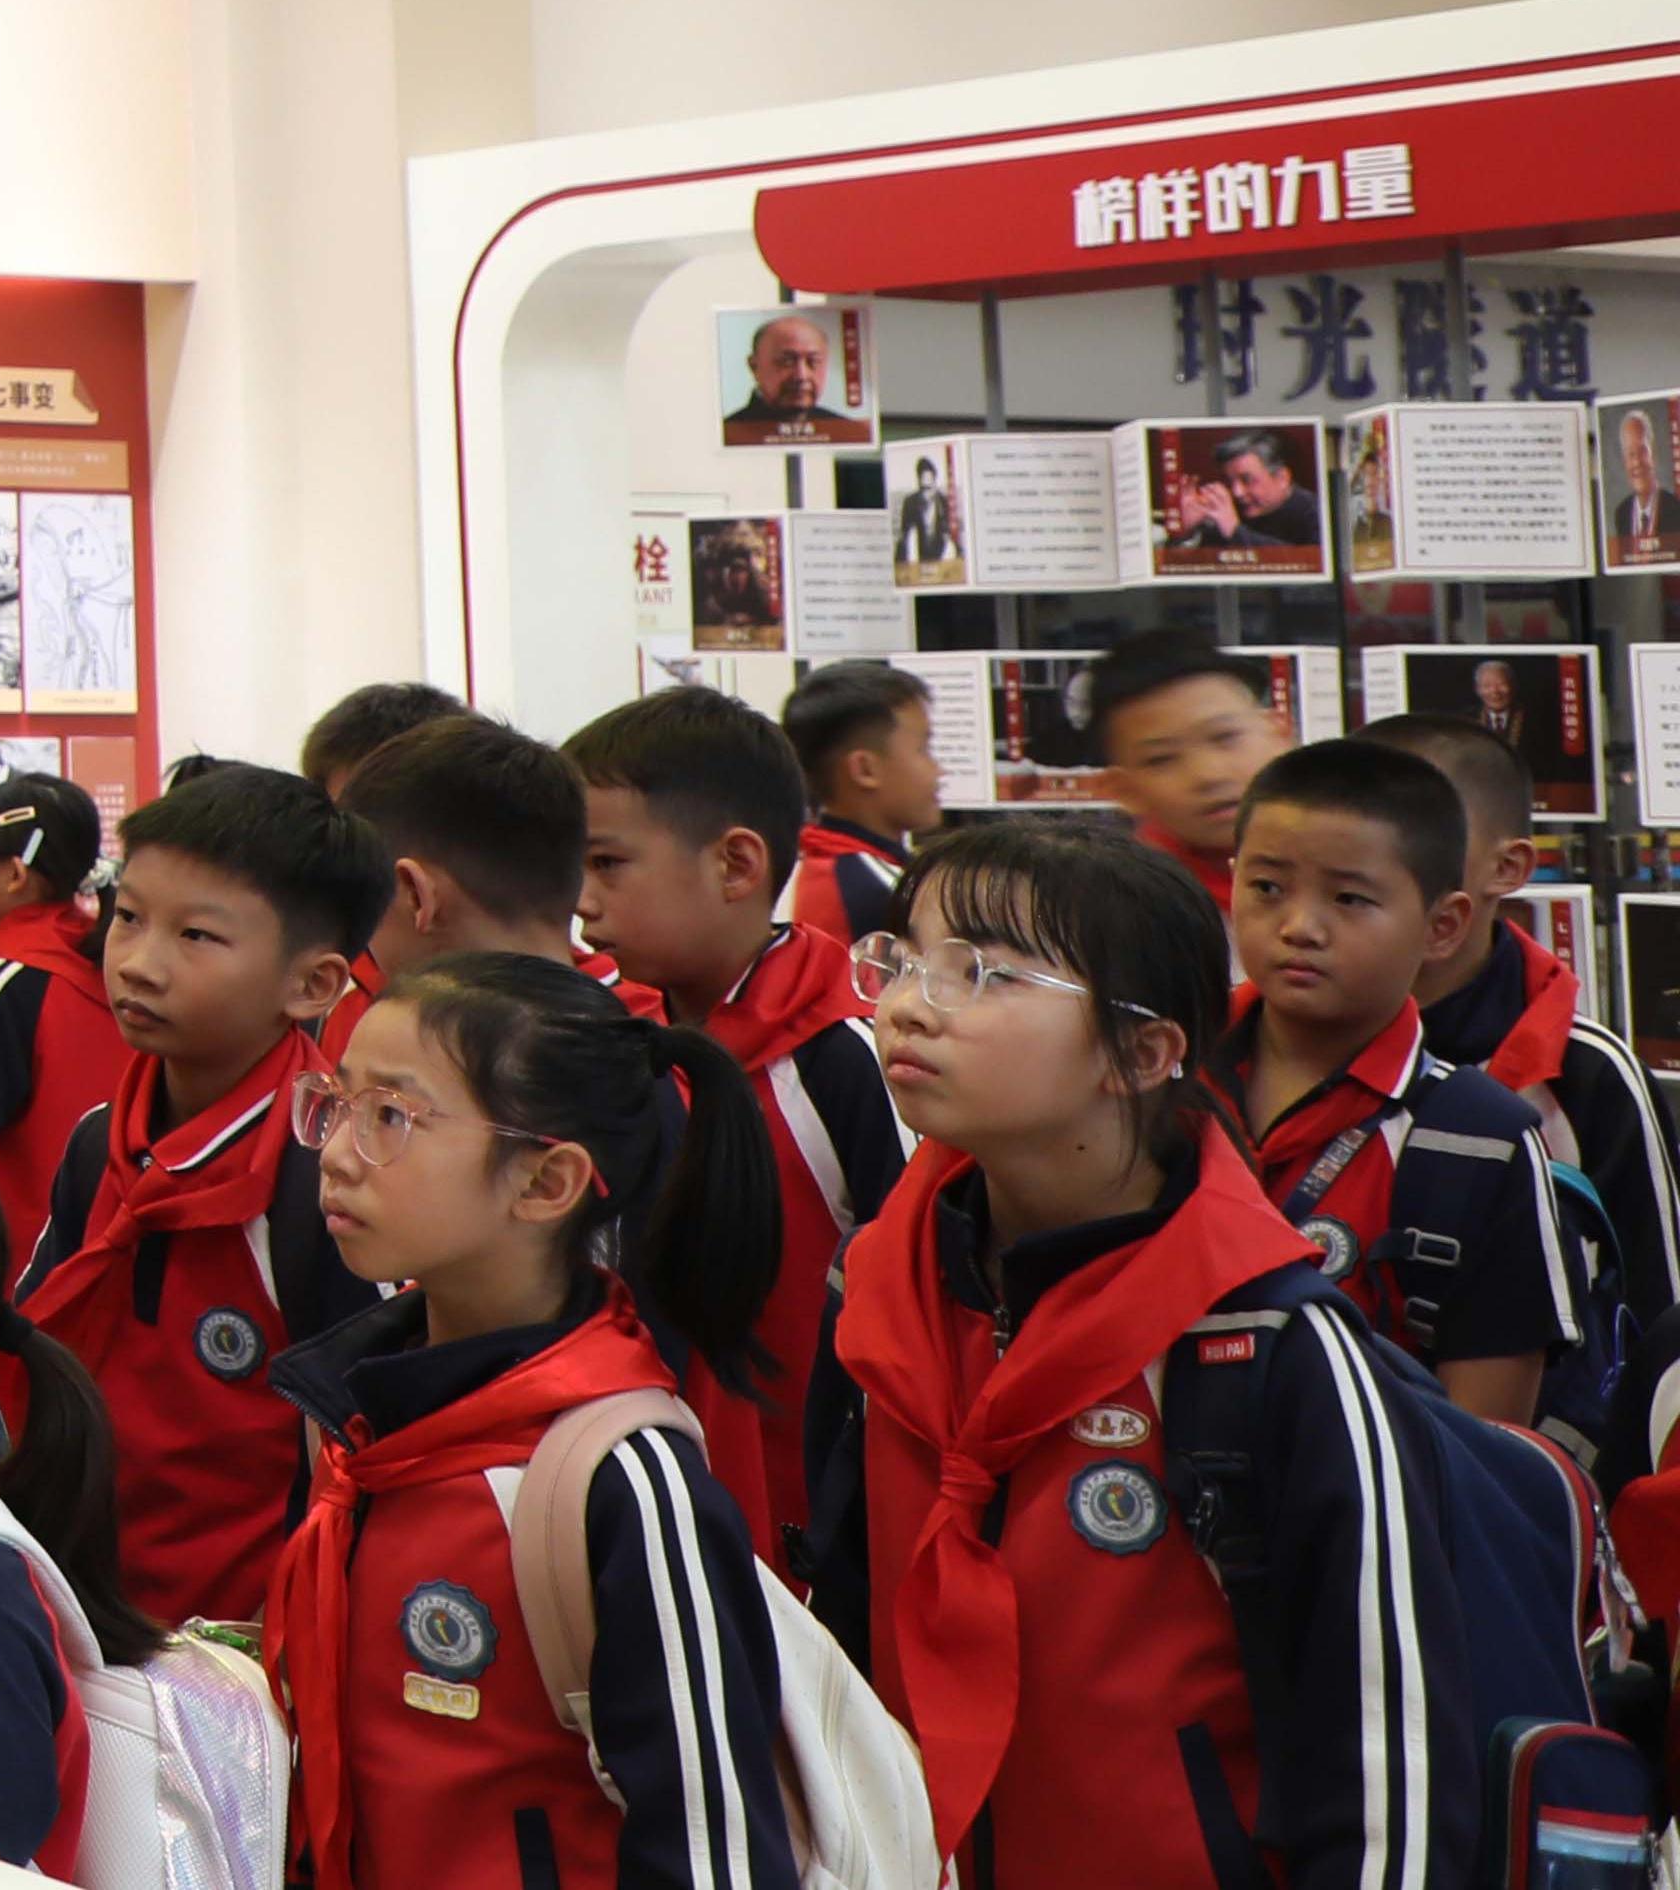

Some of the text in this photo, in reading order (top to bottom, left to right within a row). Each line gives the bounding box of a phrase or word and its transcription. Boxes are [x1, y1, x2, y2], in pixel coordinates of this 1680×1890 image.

[1073, 144, 1416, 248] 榜样的力量
